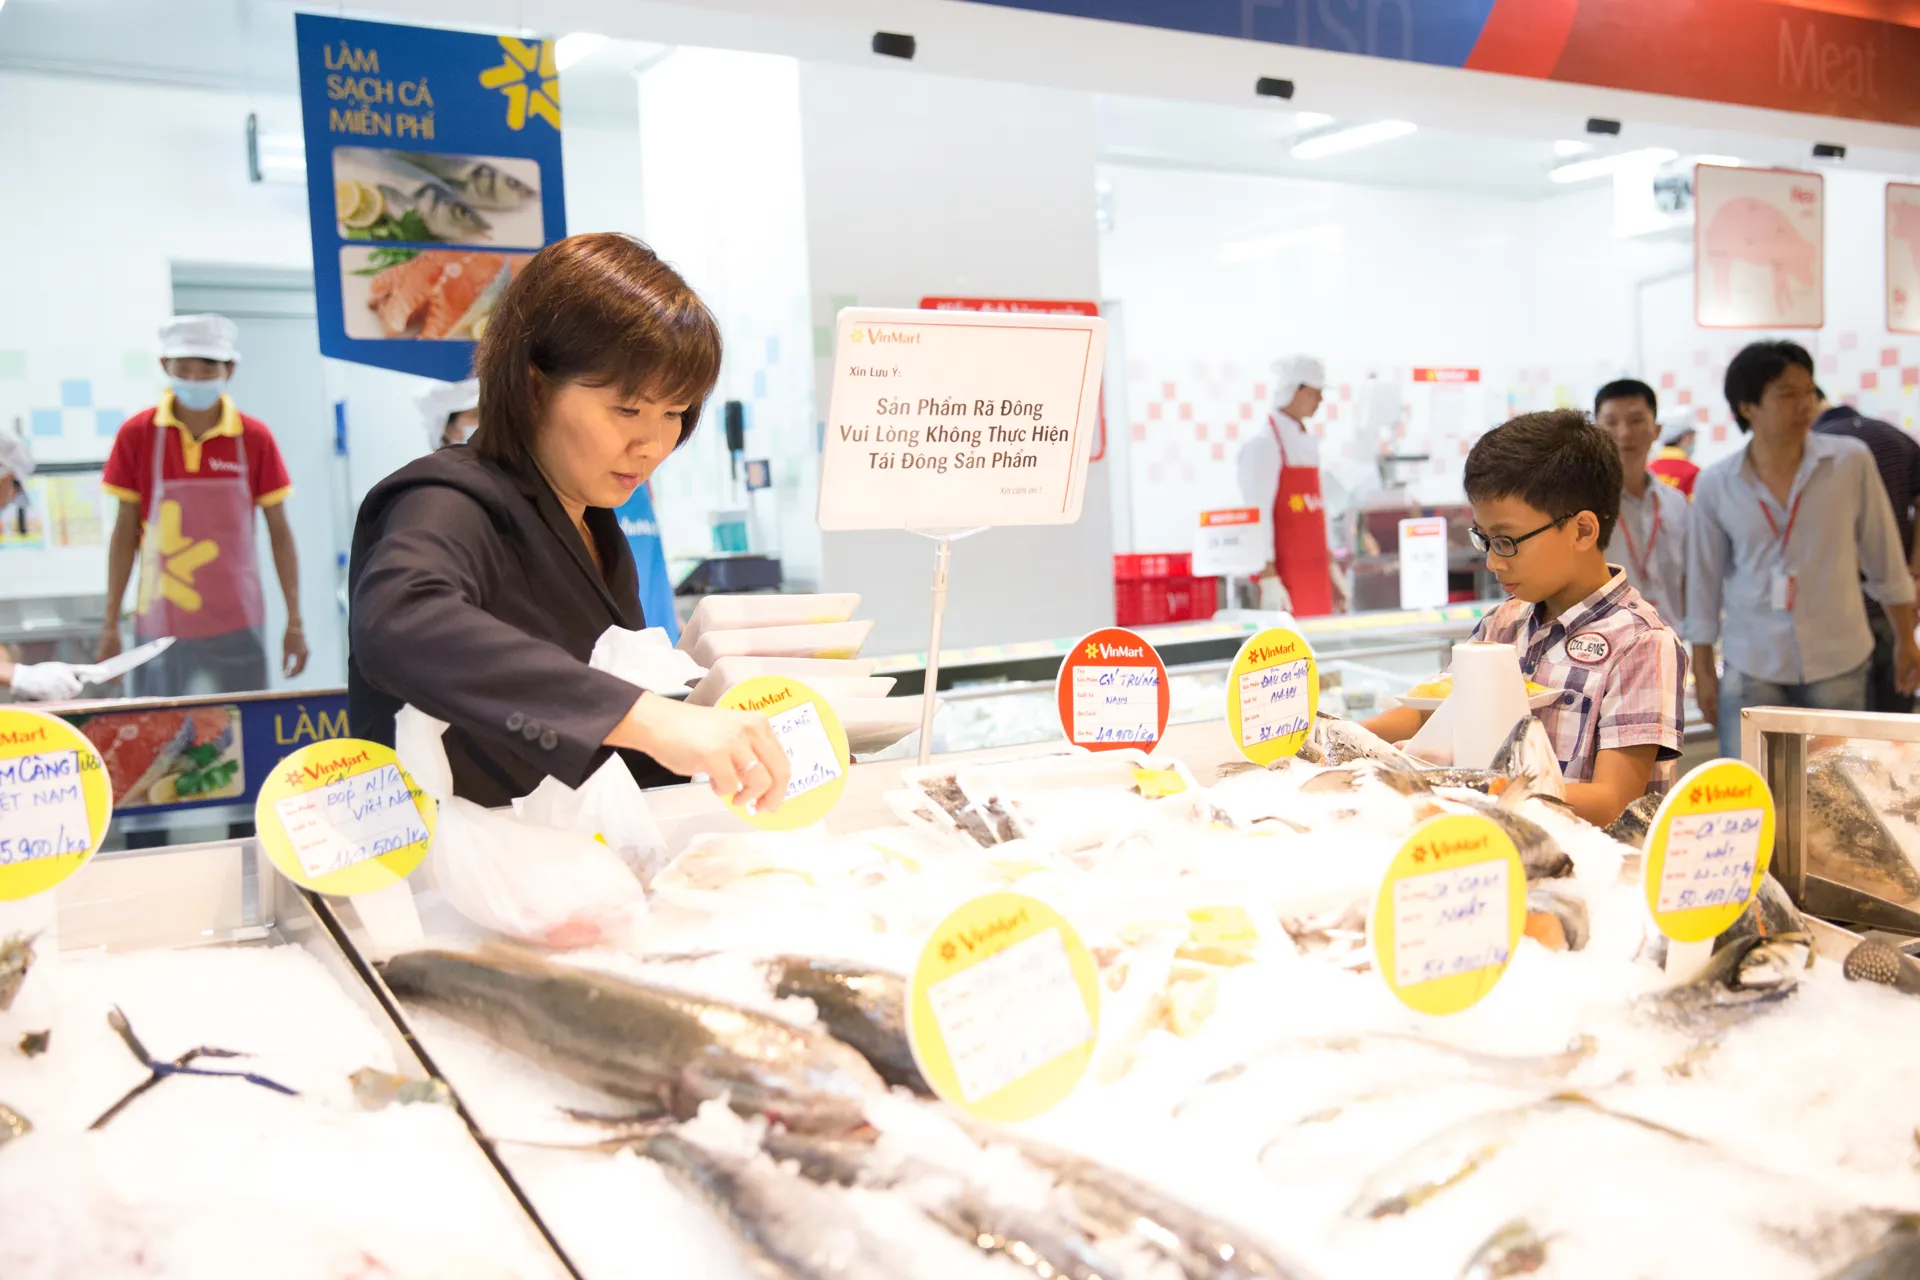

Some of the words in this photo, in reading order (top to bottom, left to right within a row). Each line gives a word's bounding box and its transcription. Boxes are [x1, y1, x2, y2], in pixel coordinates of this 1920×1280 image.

[323, 40, 379, 73] LÀM
[1777, 17, 1879, 101] Meat
[326, 74, 394, 106] SẠCH
[397, 78, 434, 108] CÁ
[329, 104, 392, 137] MIỄN
[396, 110, 435, 140] PHÍ
[867, 327, 921, 345] VinMart
[849, 366, 866, 377] Xin
[869, 367, 888, 378] Lưu
[876, 396, 910, 416] Sản
[917, 396, 967, 416] Phẩm
[973, 400, 994, 416] Rã
[1000, 399, 1044, 420] Đông
[840, 425, 869, 442] Vui
[875, 425, 919, 447] Lòng
[926, 425, 982, 447] Không
[988, 426, 1027, 446] Thực
[1032, 425, 1069, 446] Hiện
[869, 452, 895, 469] Tái
[901, 452, 948, 474] Đông
[954, 450, 986, 469] Sản
[991, 448, 1037, 468] Phẩm
[1099, 643, 1144, 660] VinMart
[1259, 641, 1295, 662] VinMart
[738, 687, 792, 711] VinMart
[0, 727, 47, 745] Mart
[275, 704, 349, 745] LÀM
[303, 750, 371, 780] VinMart
[33, 784, 78, 807] NAM
